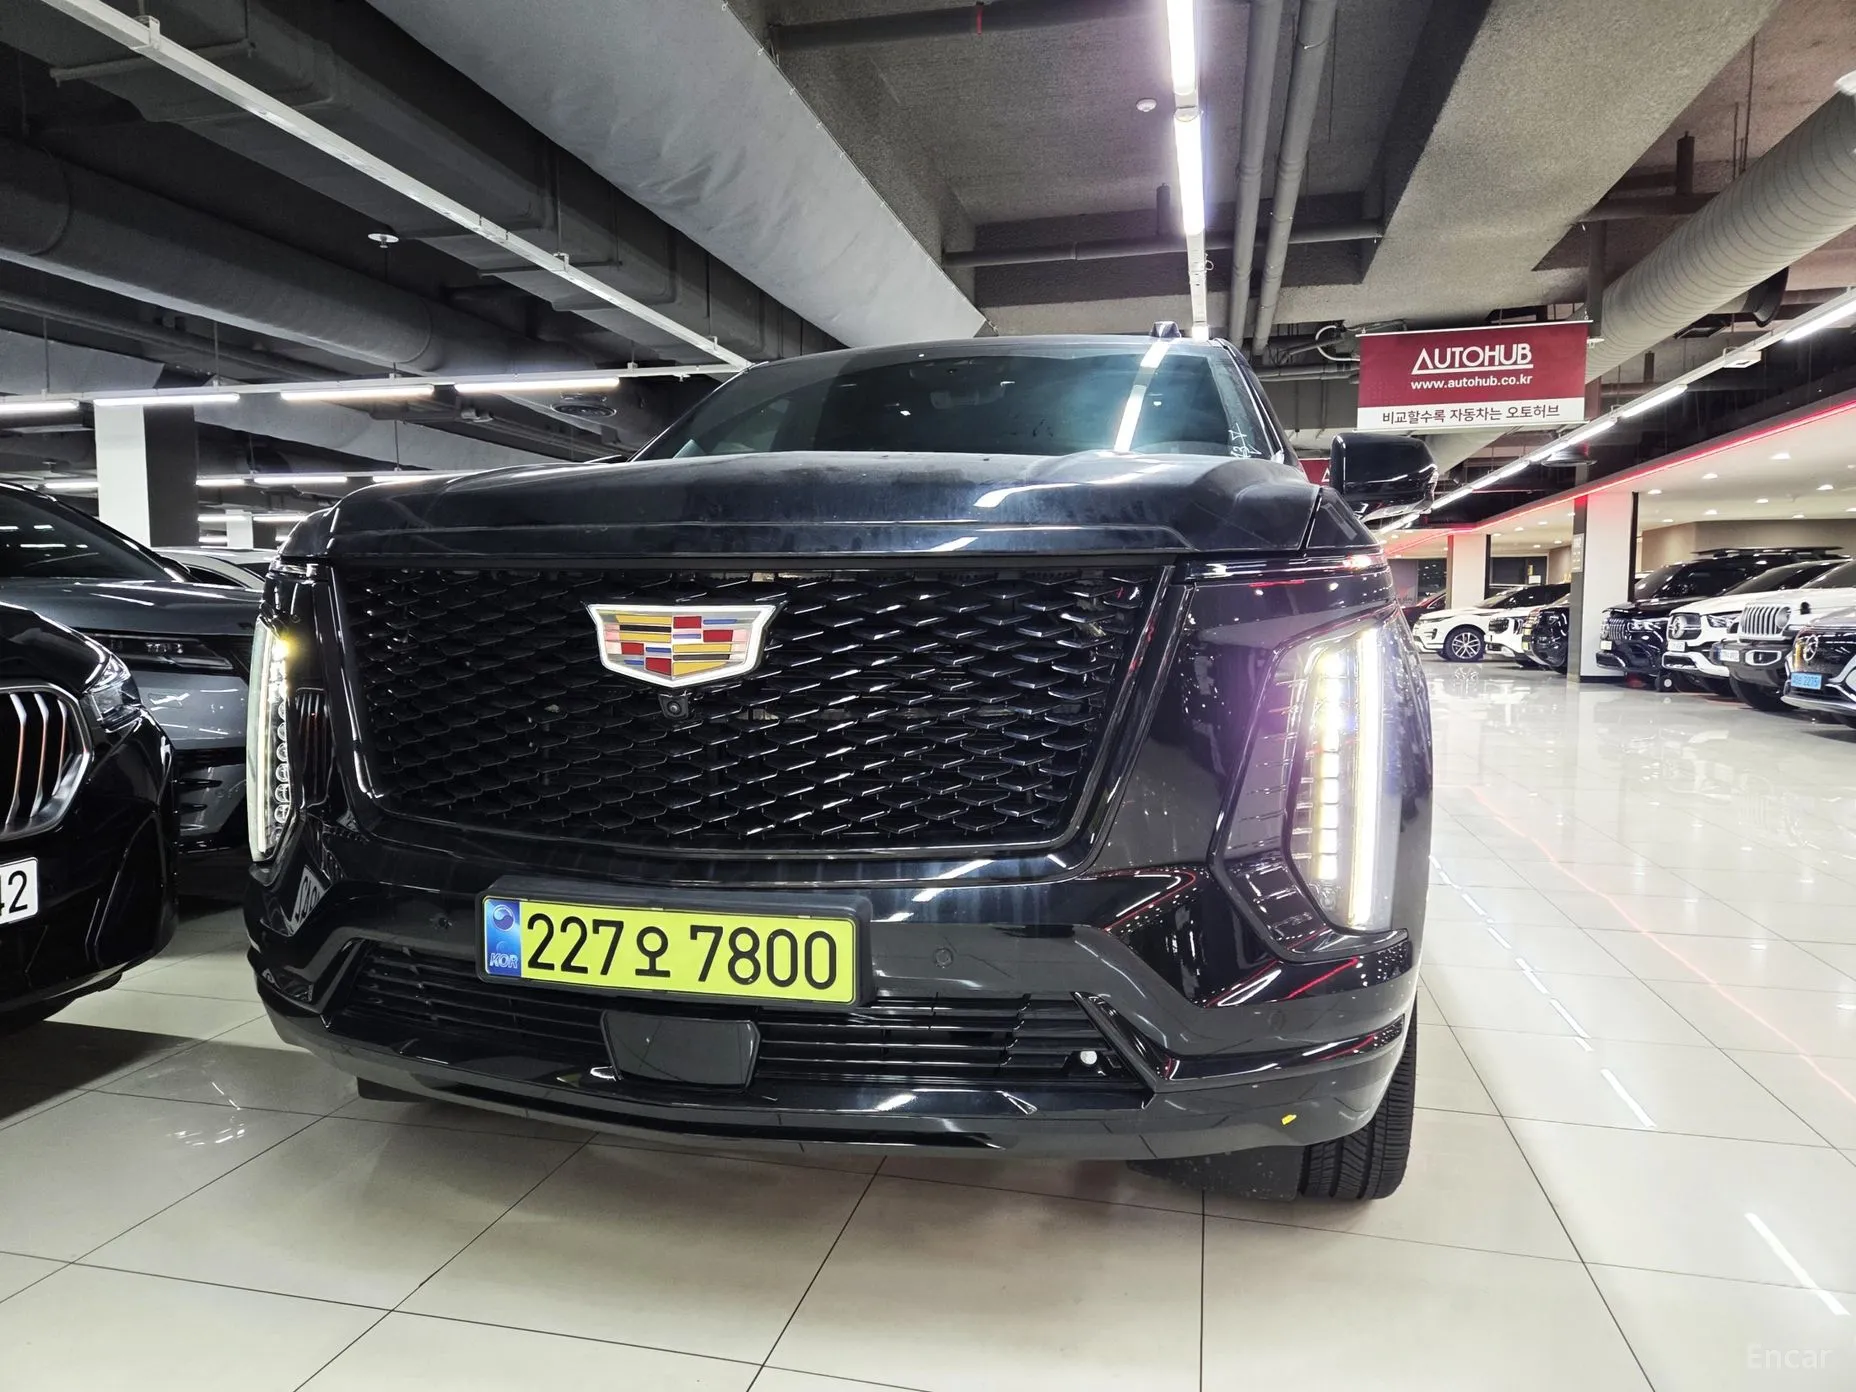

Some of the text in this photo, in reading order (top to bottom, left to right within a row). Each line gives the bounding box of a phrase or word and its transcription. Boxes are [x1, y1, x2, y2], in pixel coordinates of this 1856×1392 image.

[1411, 343, 1534, 375] AUTOHUB
[1410, 374, 1533, 390] www.autohub.co.kr
[1382, 404, 1560, 425] 비교할수록 자동차는 오토허브
[0, 870, 28, 914] 2
[489, 952, 519, 969] KOR
[526, 912, 837, 990] 227오 7800
